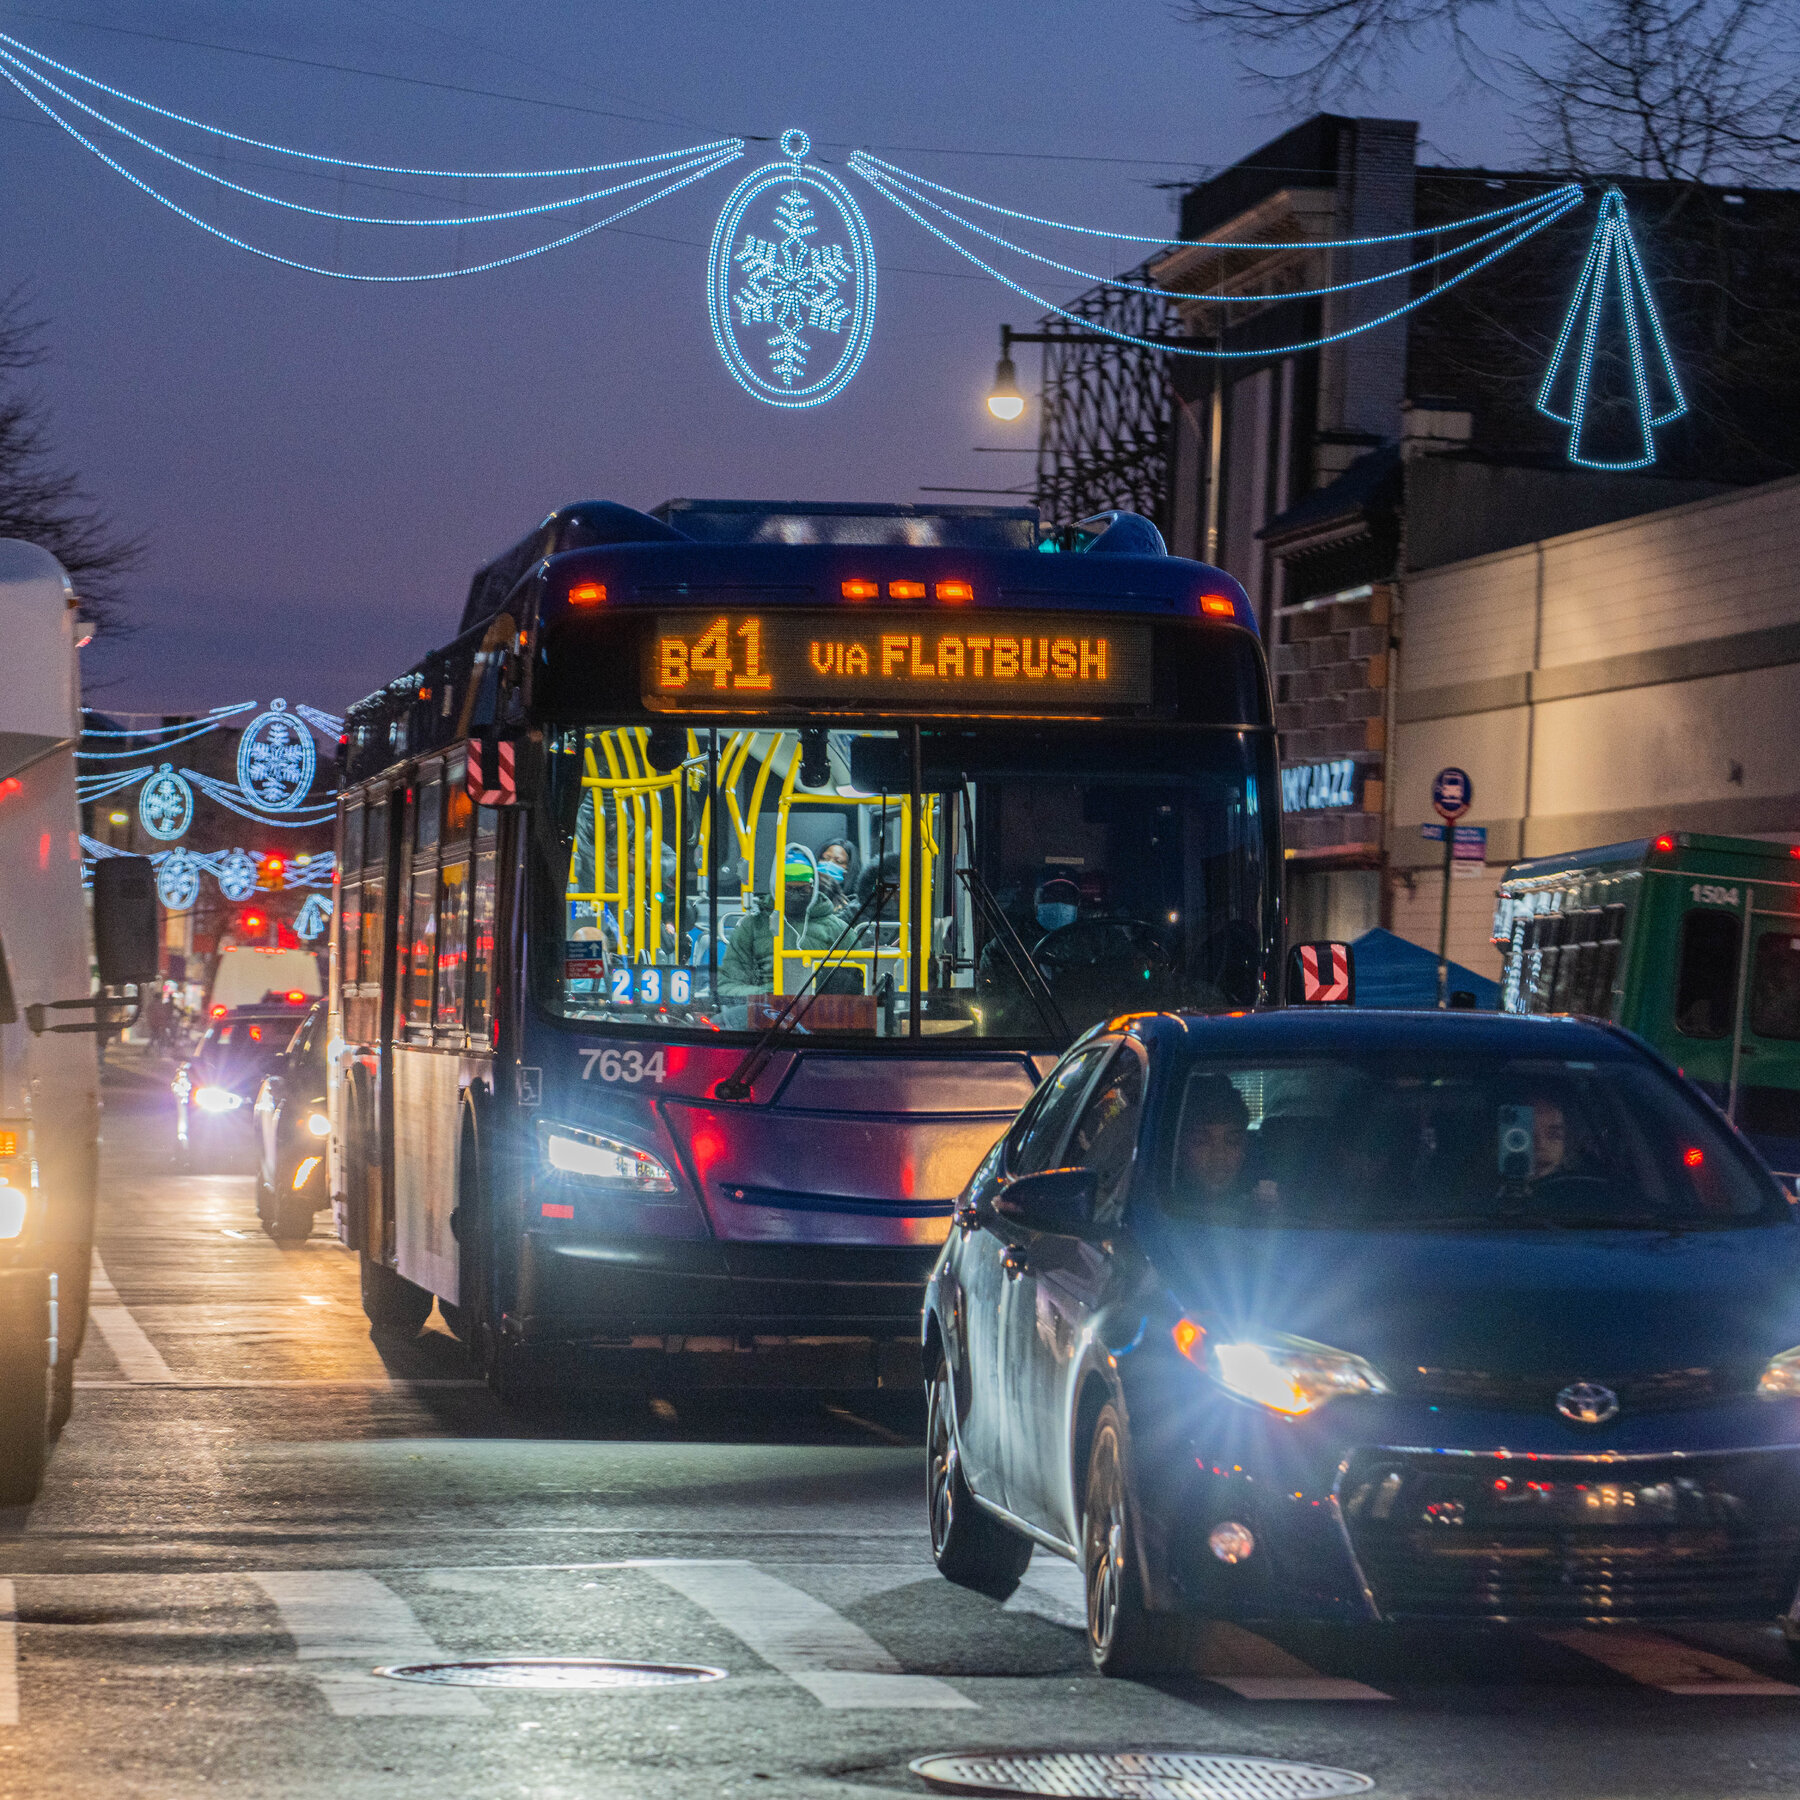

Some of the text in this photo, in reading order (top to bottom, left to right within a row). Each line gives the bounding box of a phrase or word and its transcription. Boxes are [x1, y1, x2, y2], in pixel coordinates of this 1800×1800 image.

[660, 618, 1107, 690] B41 VIA FLATBUSH
[578, 1049, 667, 1083] 7634
